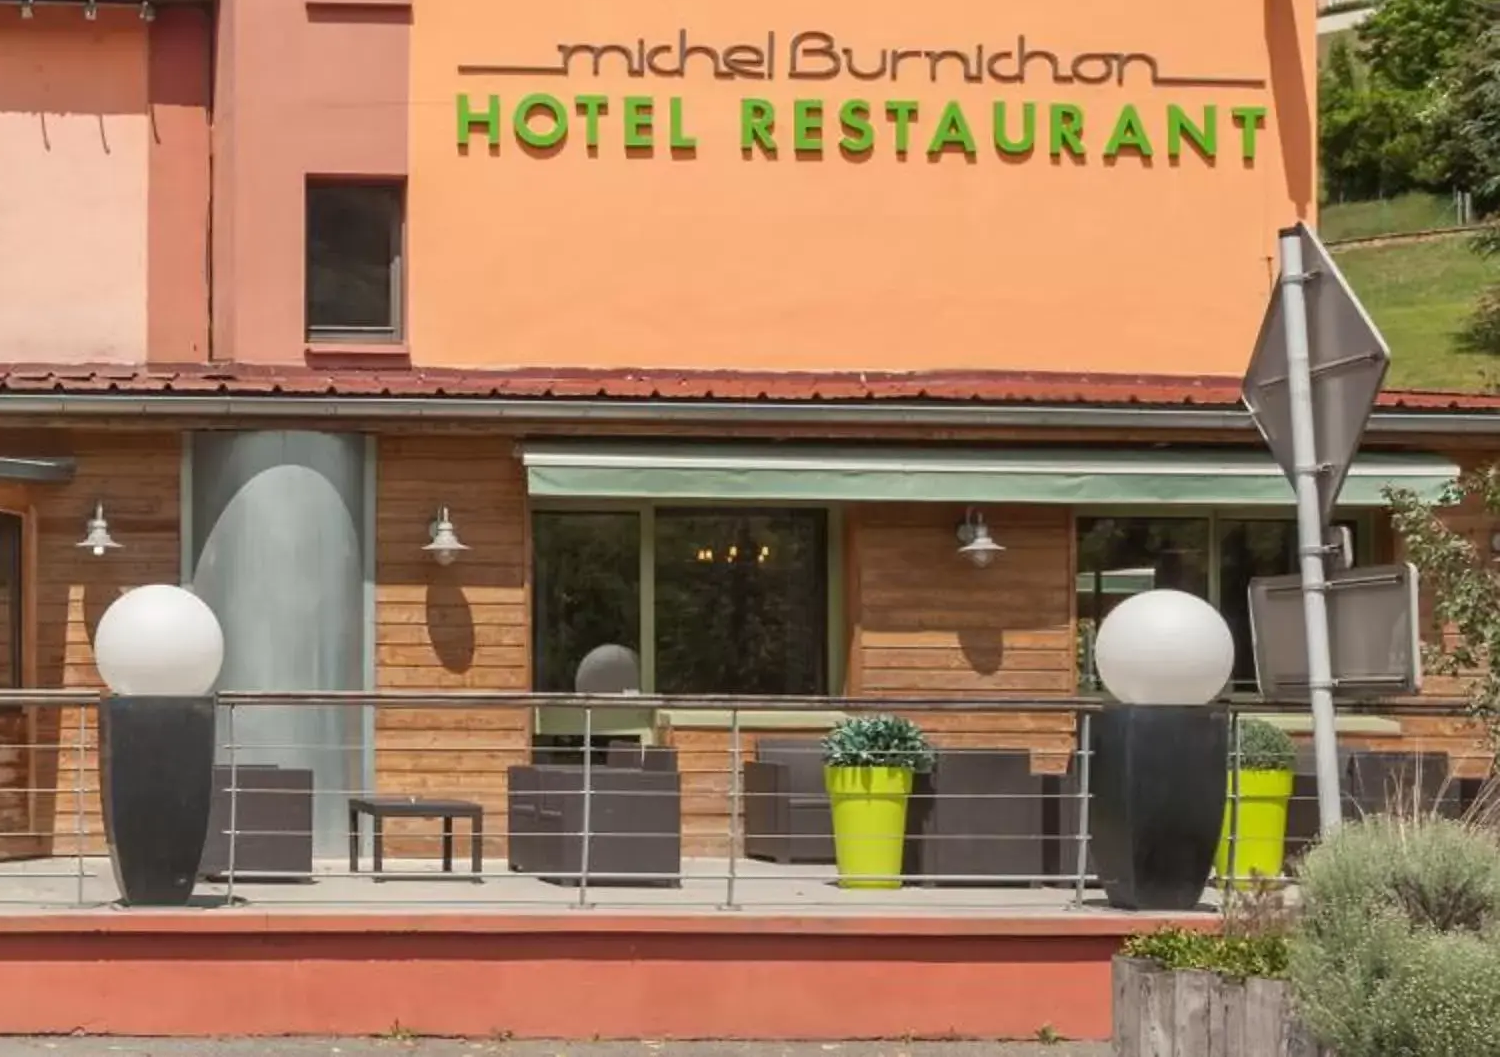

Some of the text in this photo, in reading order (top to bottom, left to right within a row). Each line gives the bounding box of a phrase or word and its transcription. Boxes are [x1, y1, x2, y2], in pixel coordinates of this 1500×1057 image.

[556, 28, 1160, 87] michel Burnichon
[456, 93, 1268, 161] HOTEL RESTAURANT
